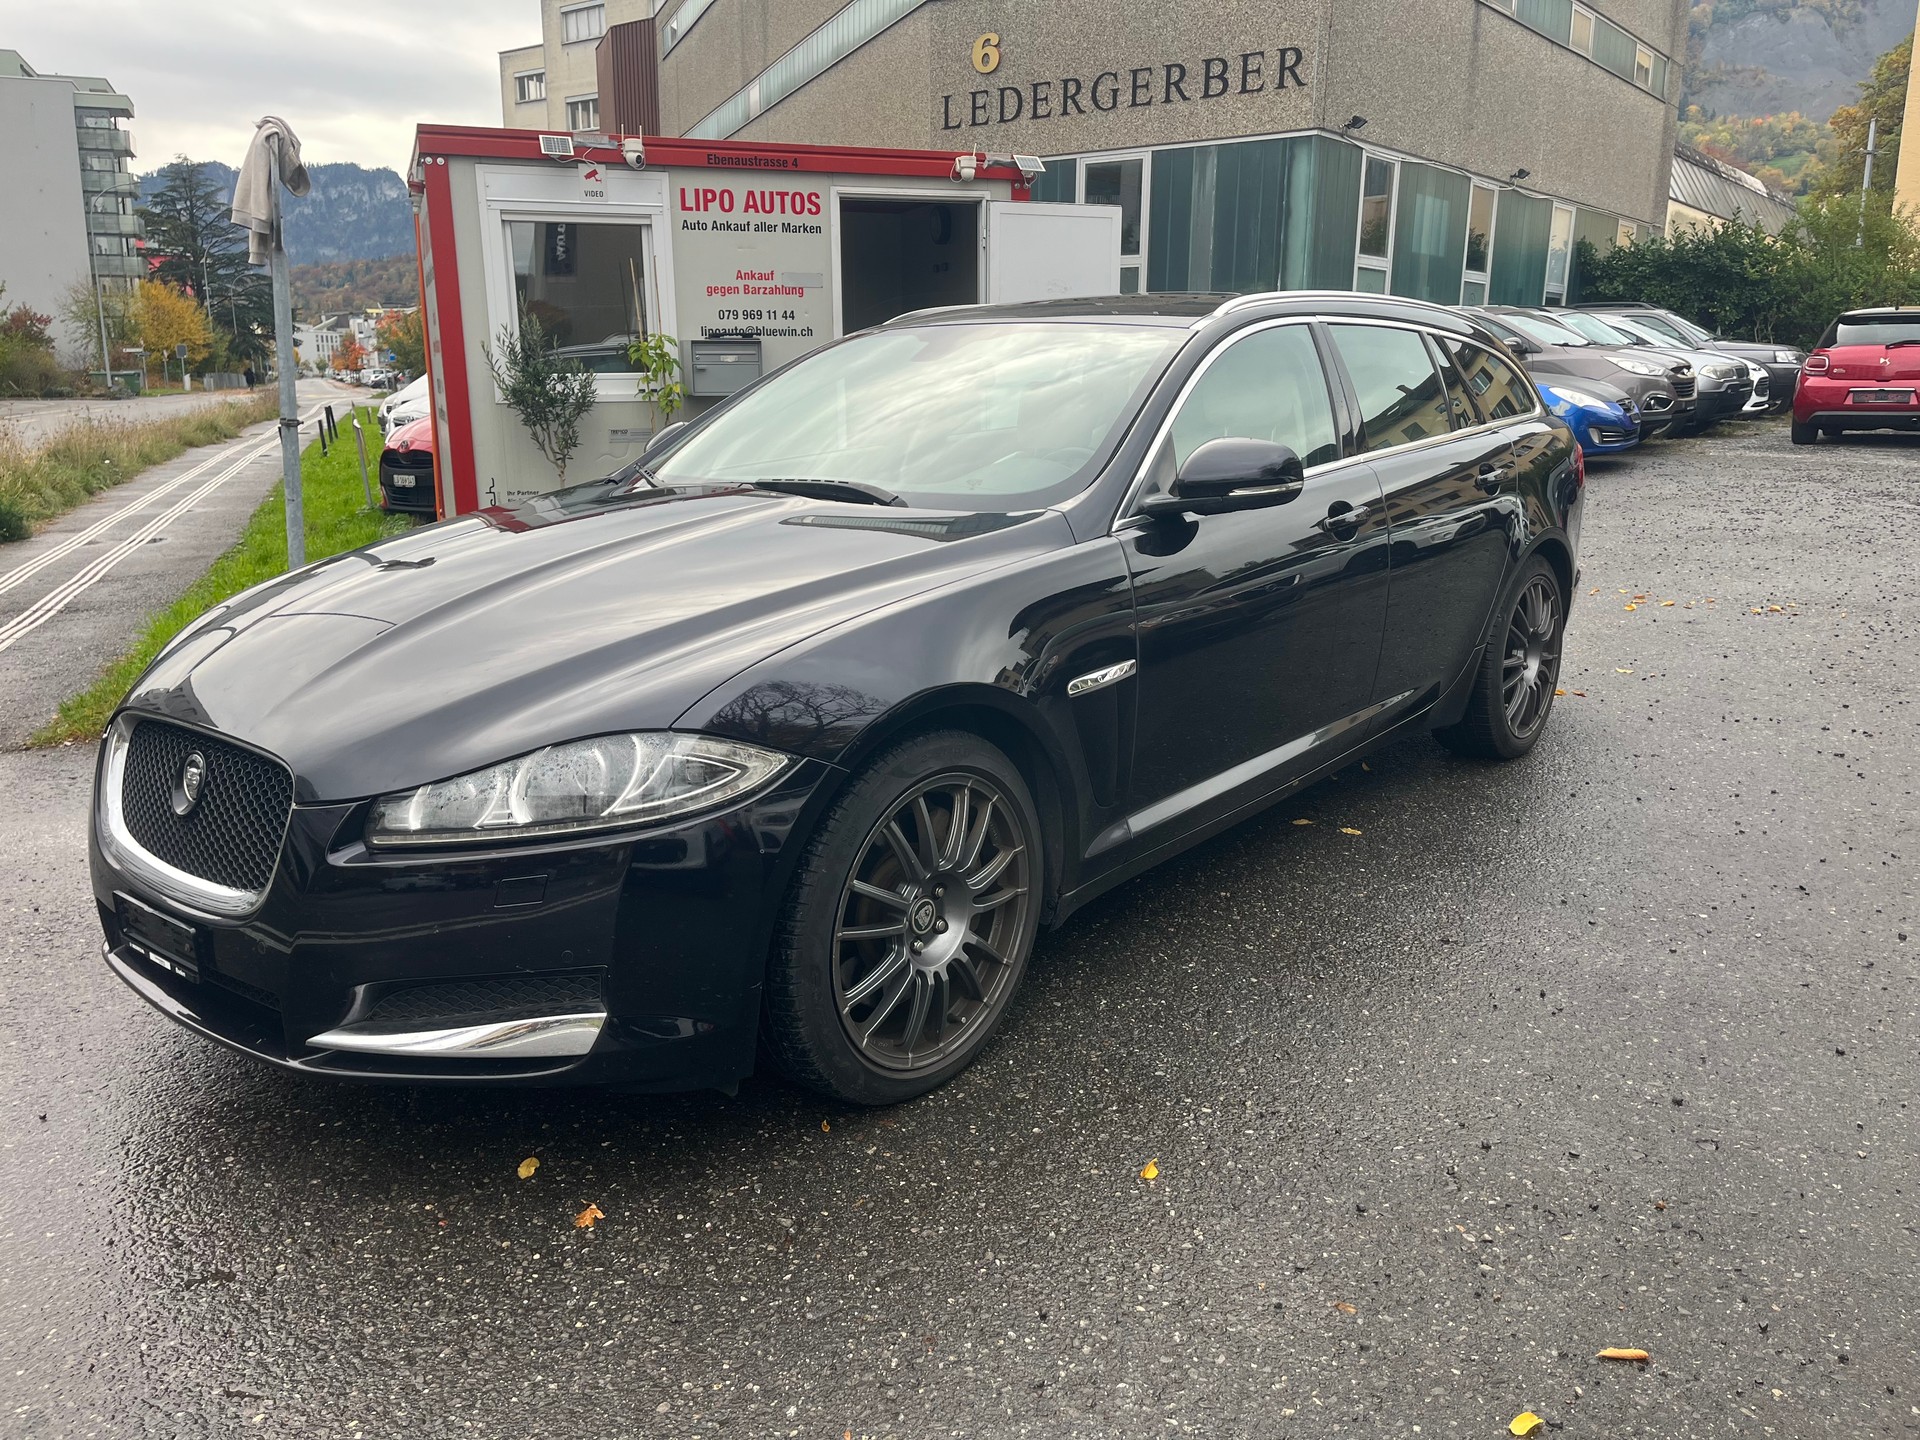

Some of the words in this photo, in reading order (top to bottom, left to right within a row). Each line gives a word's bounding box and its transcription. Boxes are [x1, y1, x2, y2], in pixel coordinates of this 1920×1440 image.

[971, 32, 1001, 74] 6
[940, 46, 1308, 131] LEDERGERBER
[706, 153, 788, 168] Ebenaustrasse
[791, 157, 799, 168] 4
[584, 190, 604, 198] VIDEO
[679, 187, 735, 213] LIPO
[743, 189, 821, 216] AUTOS
[681, 219, 708, 231] Auto
[711, 220, 751, 232] Ankauf
[753, 221, 778, 233] aller
[781, 222, 822, 234] Marken
[735, 269, 775, 281] Ankauf
[706, 285, 740, 297] gegen
[743, 284, 804, 297] Barzahlung
[718, 309, 739, 321] 079
[742, 309, 763, 321] 969
[766, 310, 777, 321] 11
[781, 310, 796, 321] 44
